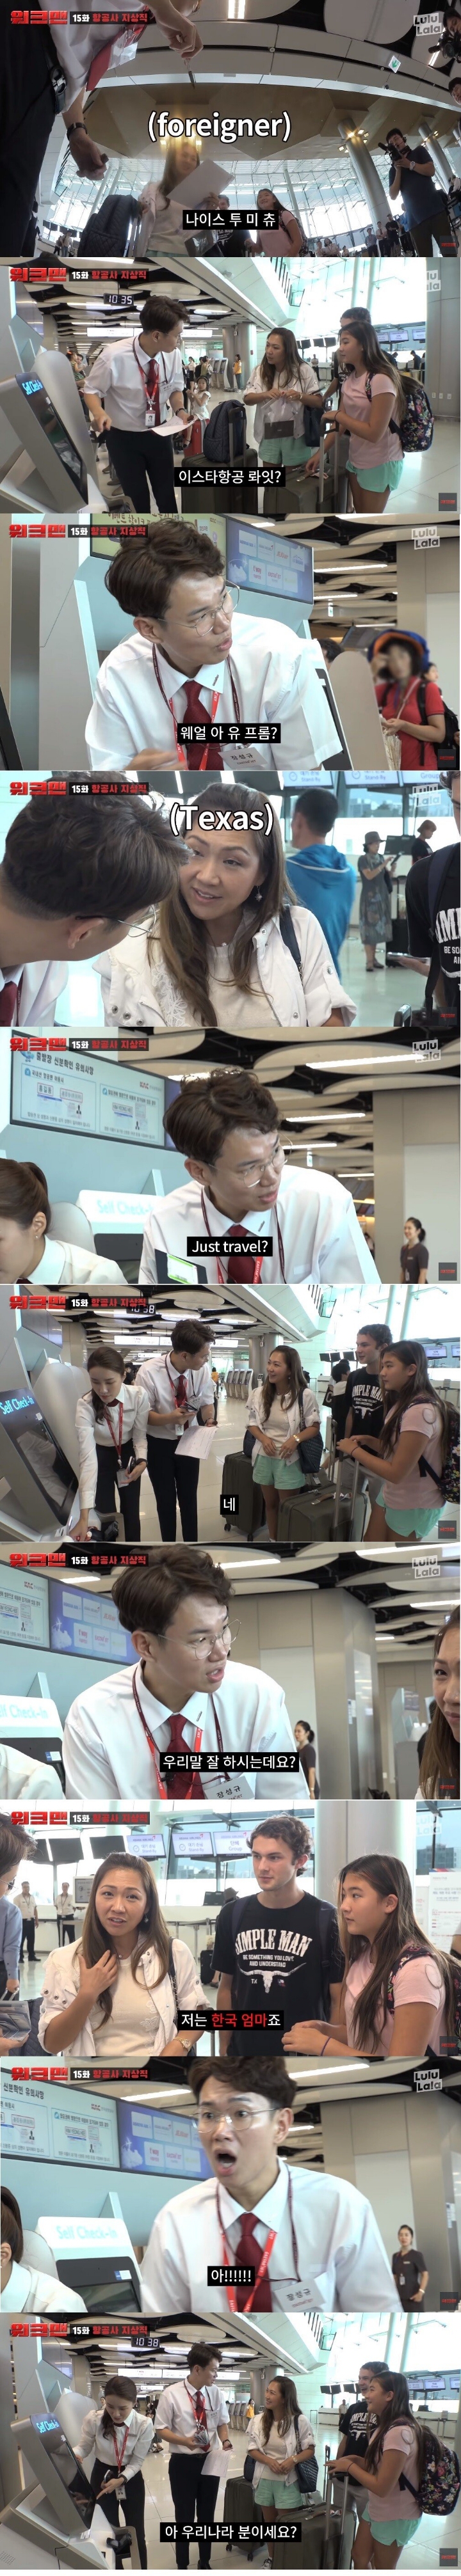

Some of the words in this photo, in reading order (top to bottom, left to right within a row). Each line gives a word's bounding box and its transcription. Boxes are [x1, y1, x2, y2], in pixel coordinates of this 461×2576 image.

[97, 1200, 115, 1213] Self
[0, 1400, 13, 1414] Self
[12, 1396, 35, 1410] Check-In
[9, 1704, 49, 1719] Check-In
[278, 1930, 312, 1957] MAN
[56, 2225, 74, 2239] Self
[76, 2225, 118, 2239] Check-In
